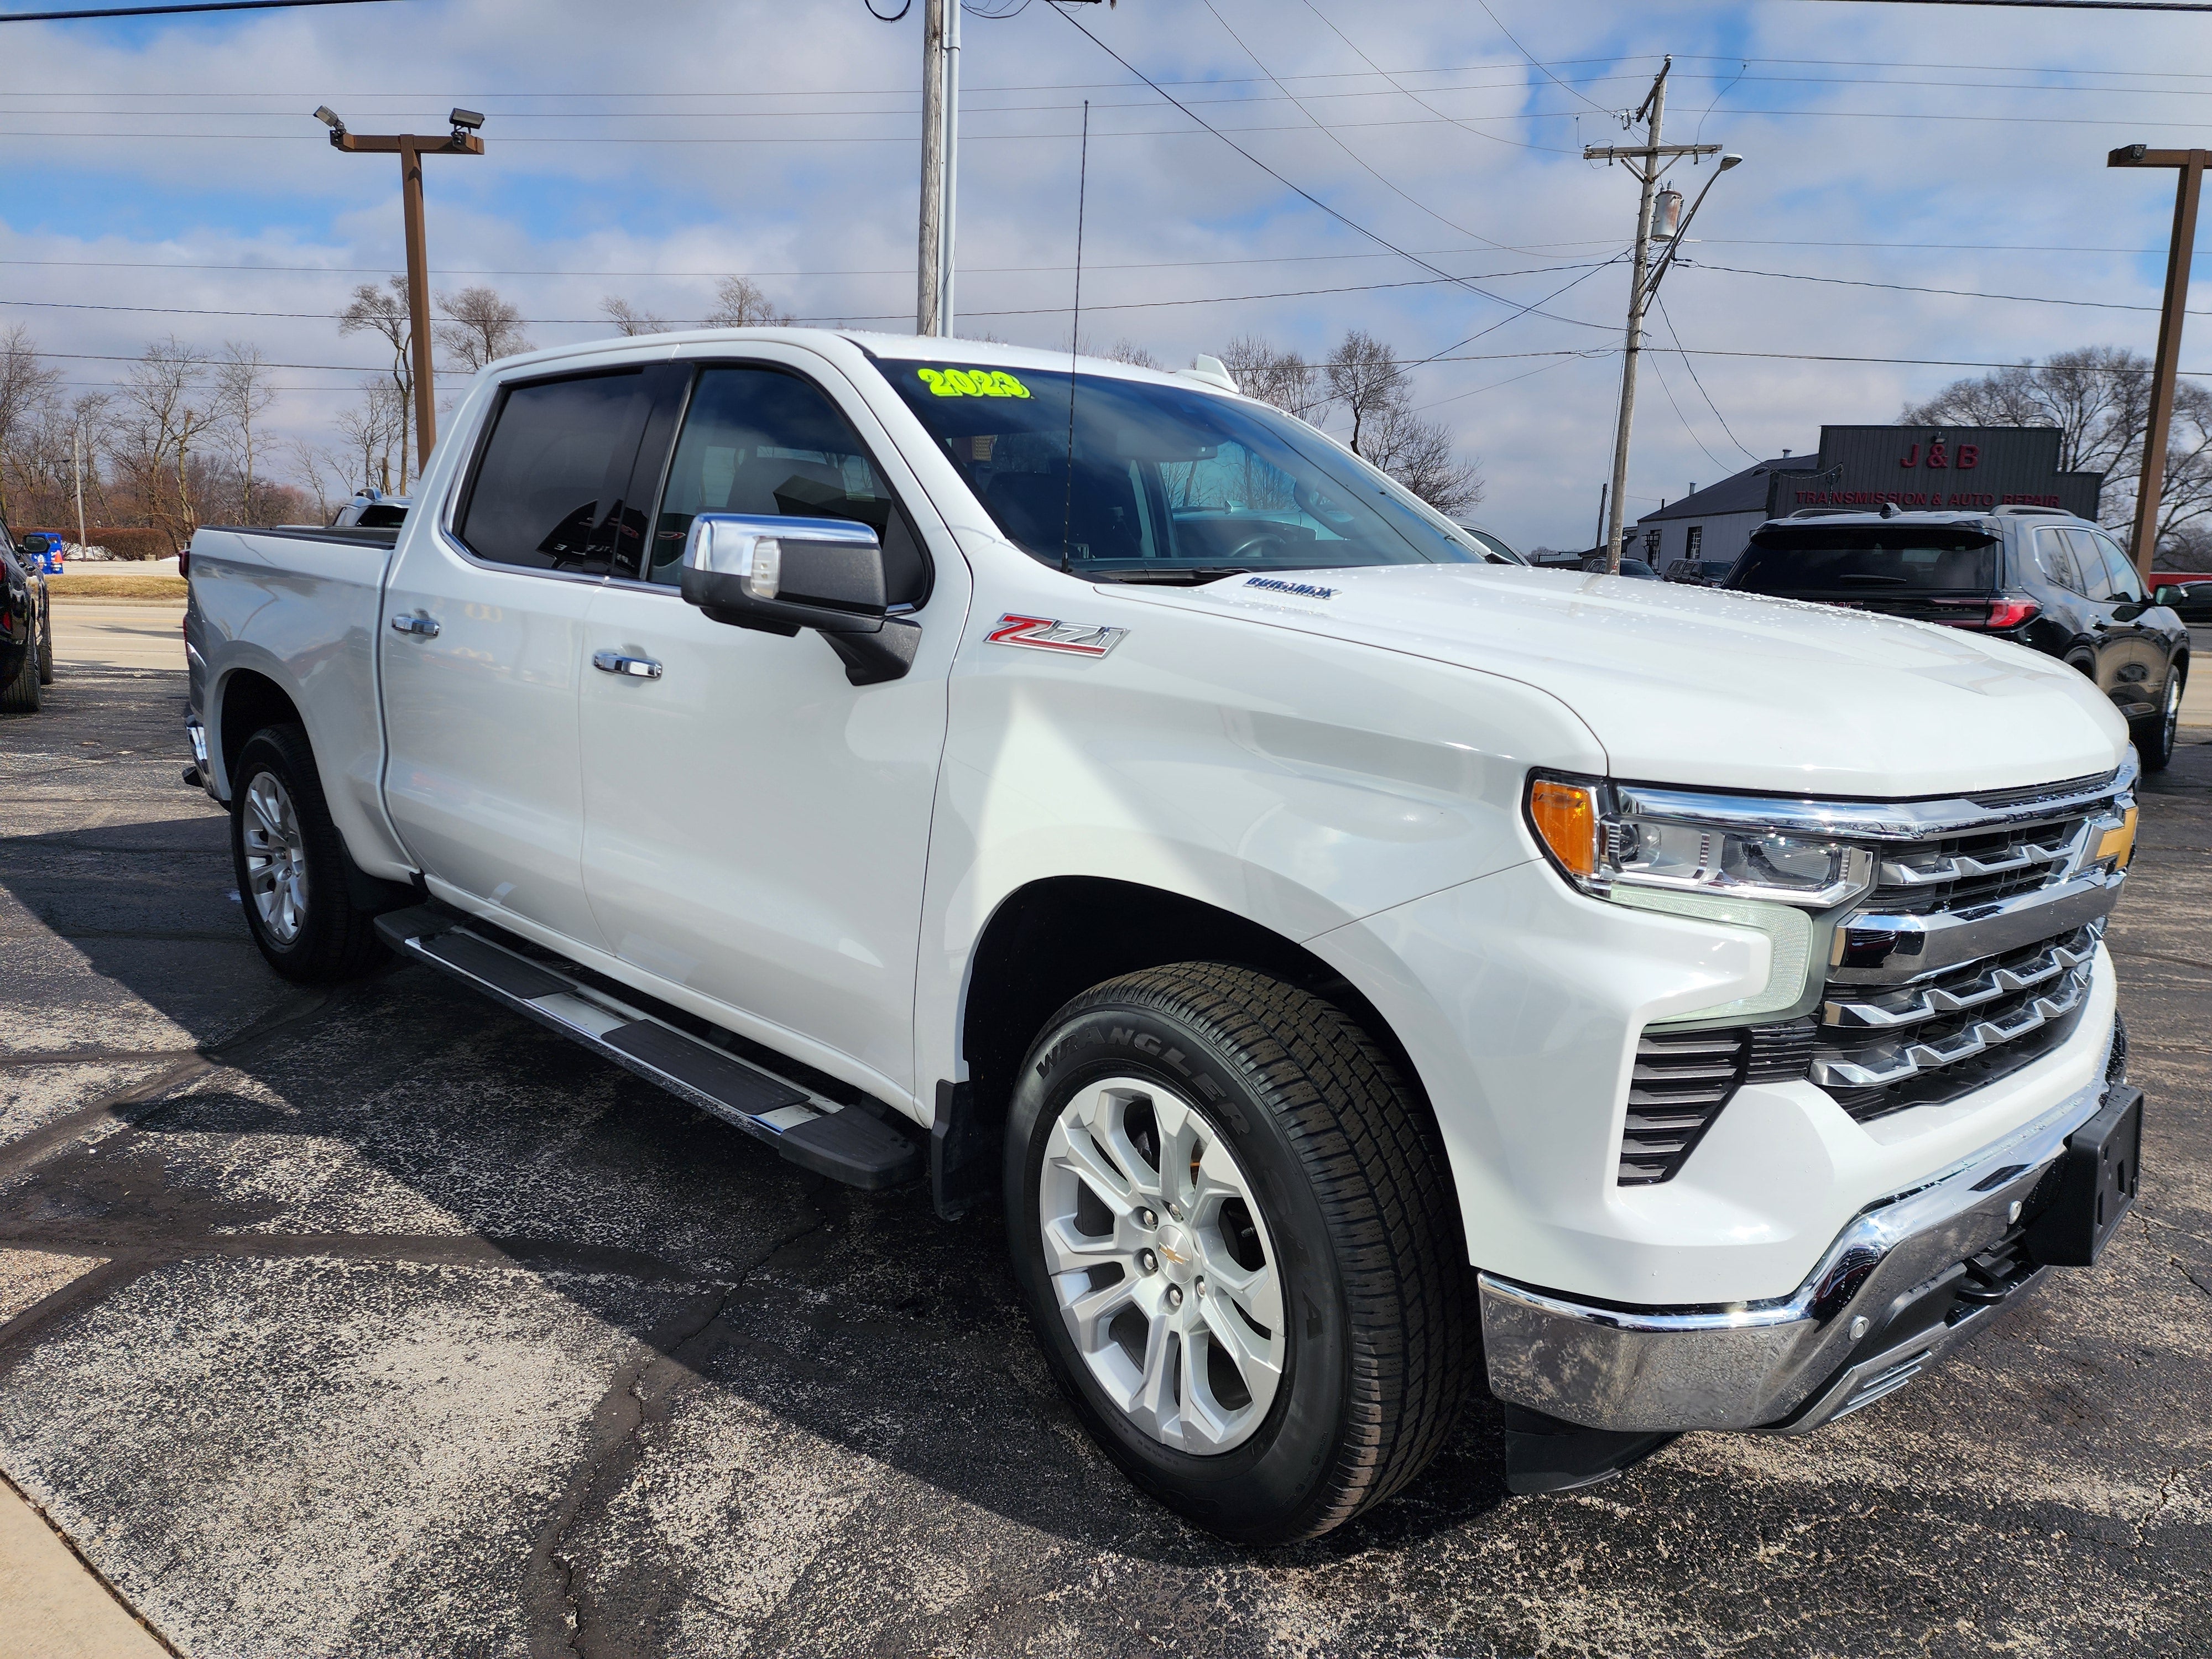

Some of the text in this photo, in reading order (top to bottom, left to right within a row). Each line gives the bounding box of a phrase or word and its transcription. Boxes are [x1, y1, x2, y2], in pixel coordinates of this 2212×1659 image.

[917, 368, 1030, 398] 2023
[1900, 444, 1980, 468] J & B
[1796, 491, 2060, 508] TRANSMISSION & AUTO REPAIR
[1243, 577, 1342, 600] DURAMAX
[982, 612, 1130, 659] Z71
[1036, 1026, 1250, 1136] WRANGLER
